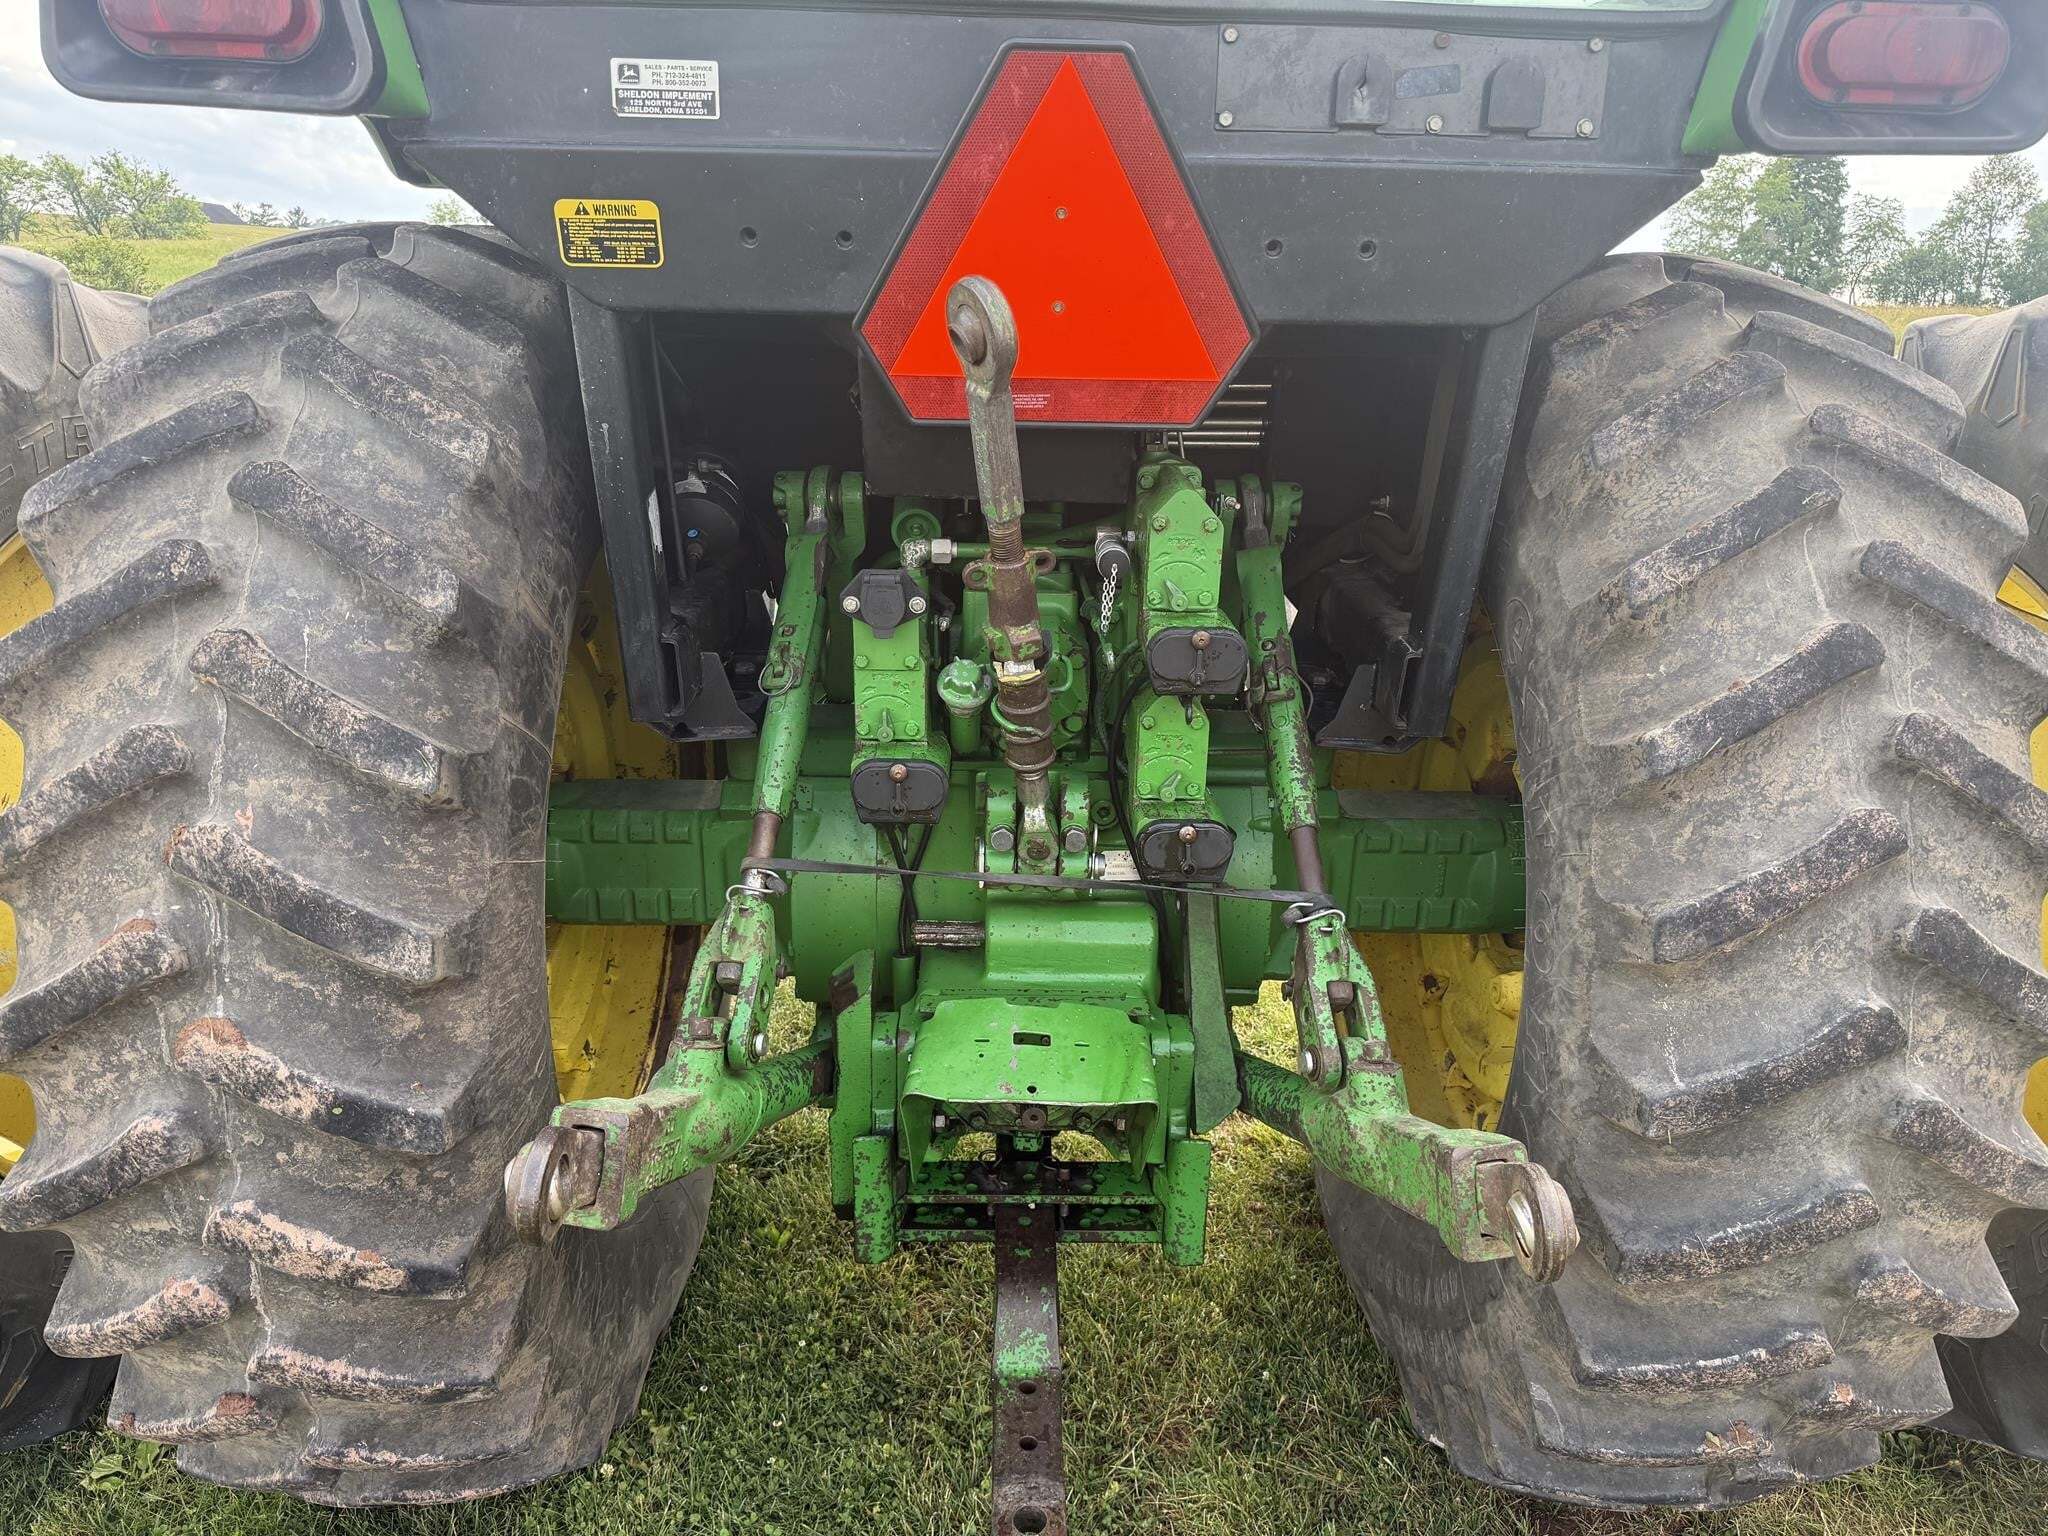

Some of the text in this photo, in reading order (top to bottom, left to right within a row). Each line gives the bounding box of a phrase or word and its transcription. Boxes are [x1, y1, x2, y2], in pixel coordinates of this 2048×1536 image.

[618, 89, 713, 101] SHELDON IMPLEMENT
[687, 100, 703, 108] AVE
[623, 106, 662, 114] SHELDON,
[592, 203, 638, 217] WARNING
